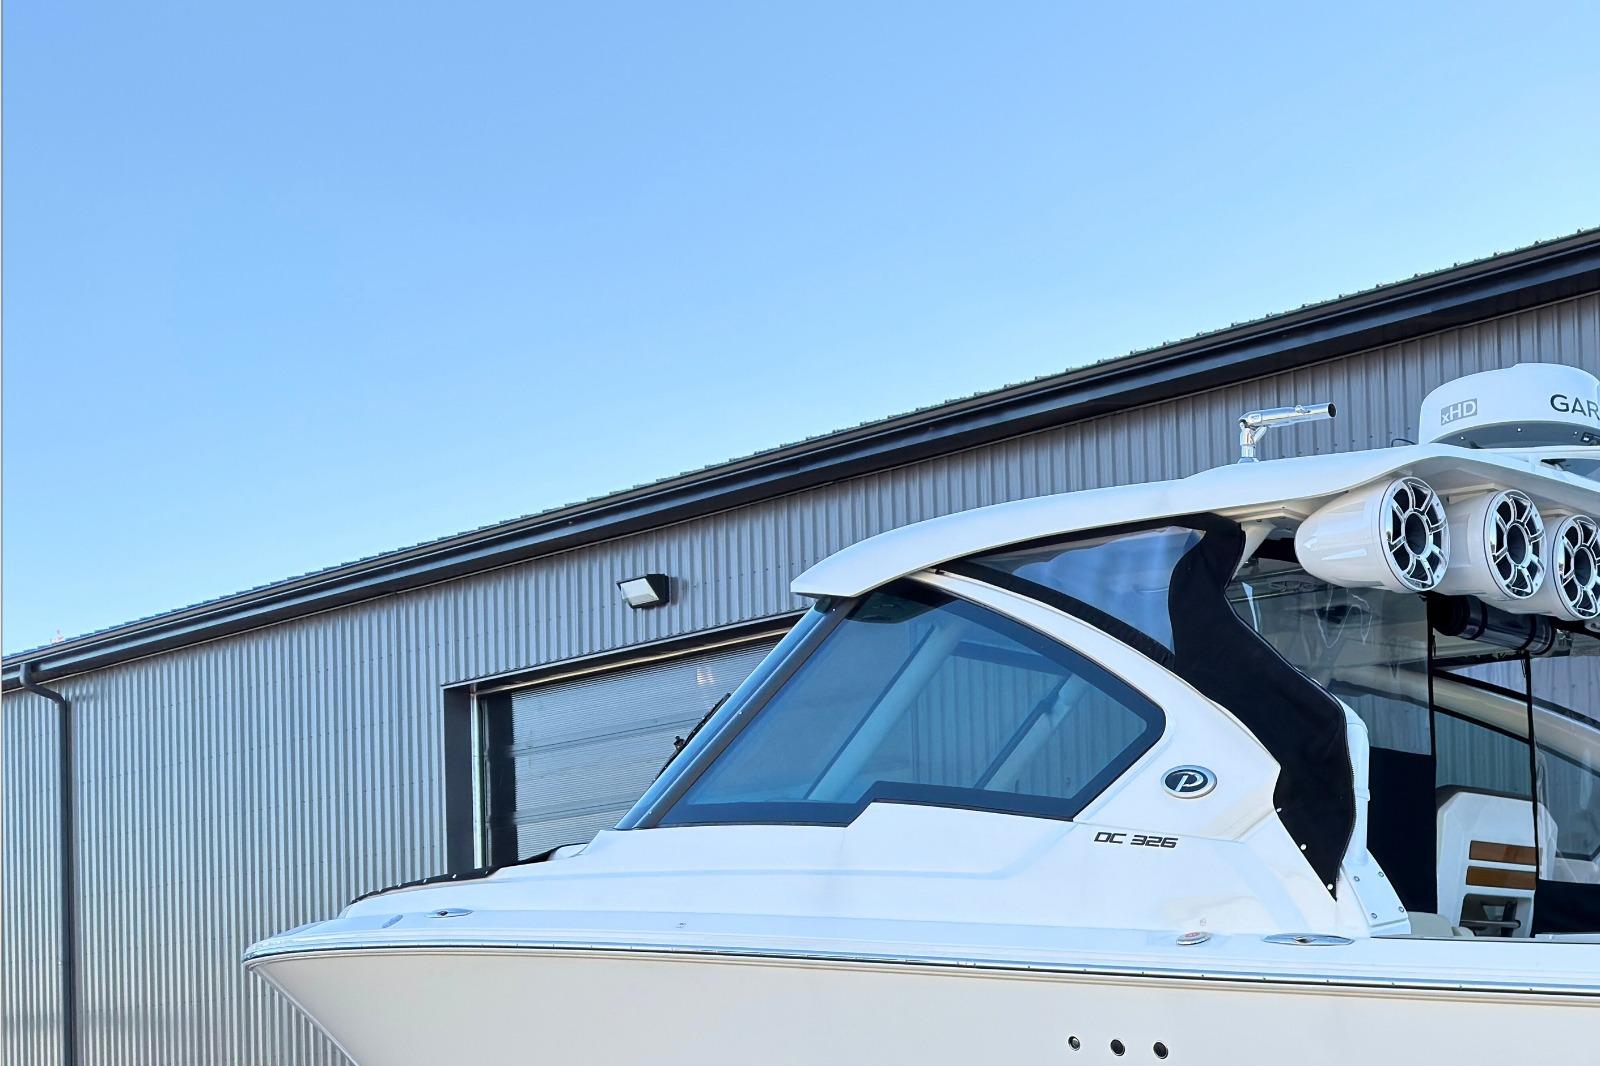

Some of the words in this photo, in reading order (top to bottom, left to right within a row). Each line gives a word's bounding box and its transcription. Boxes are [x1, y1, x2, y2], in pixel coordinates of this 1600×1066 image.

[1441, 399, 1477, 424] xHD
[1094, 832, 1127, 844] DC
[1130, 834, 1179, 849] 326
